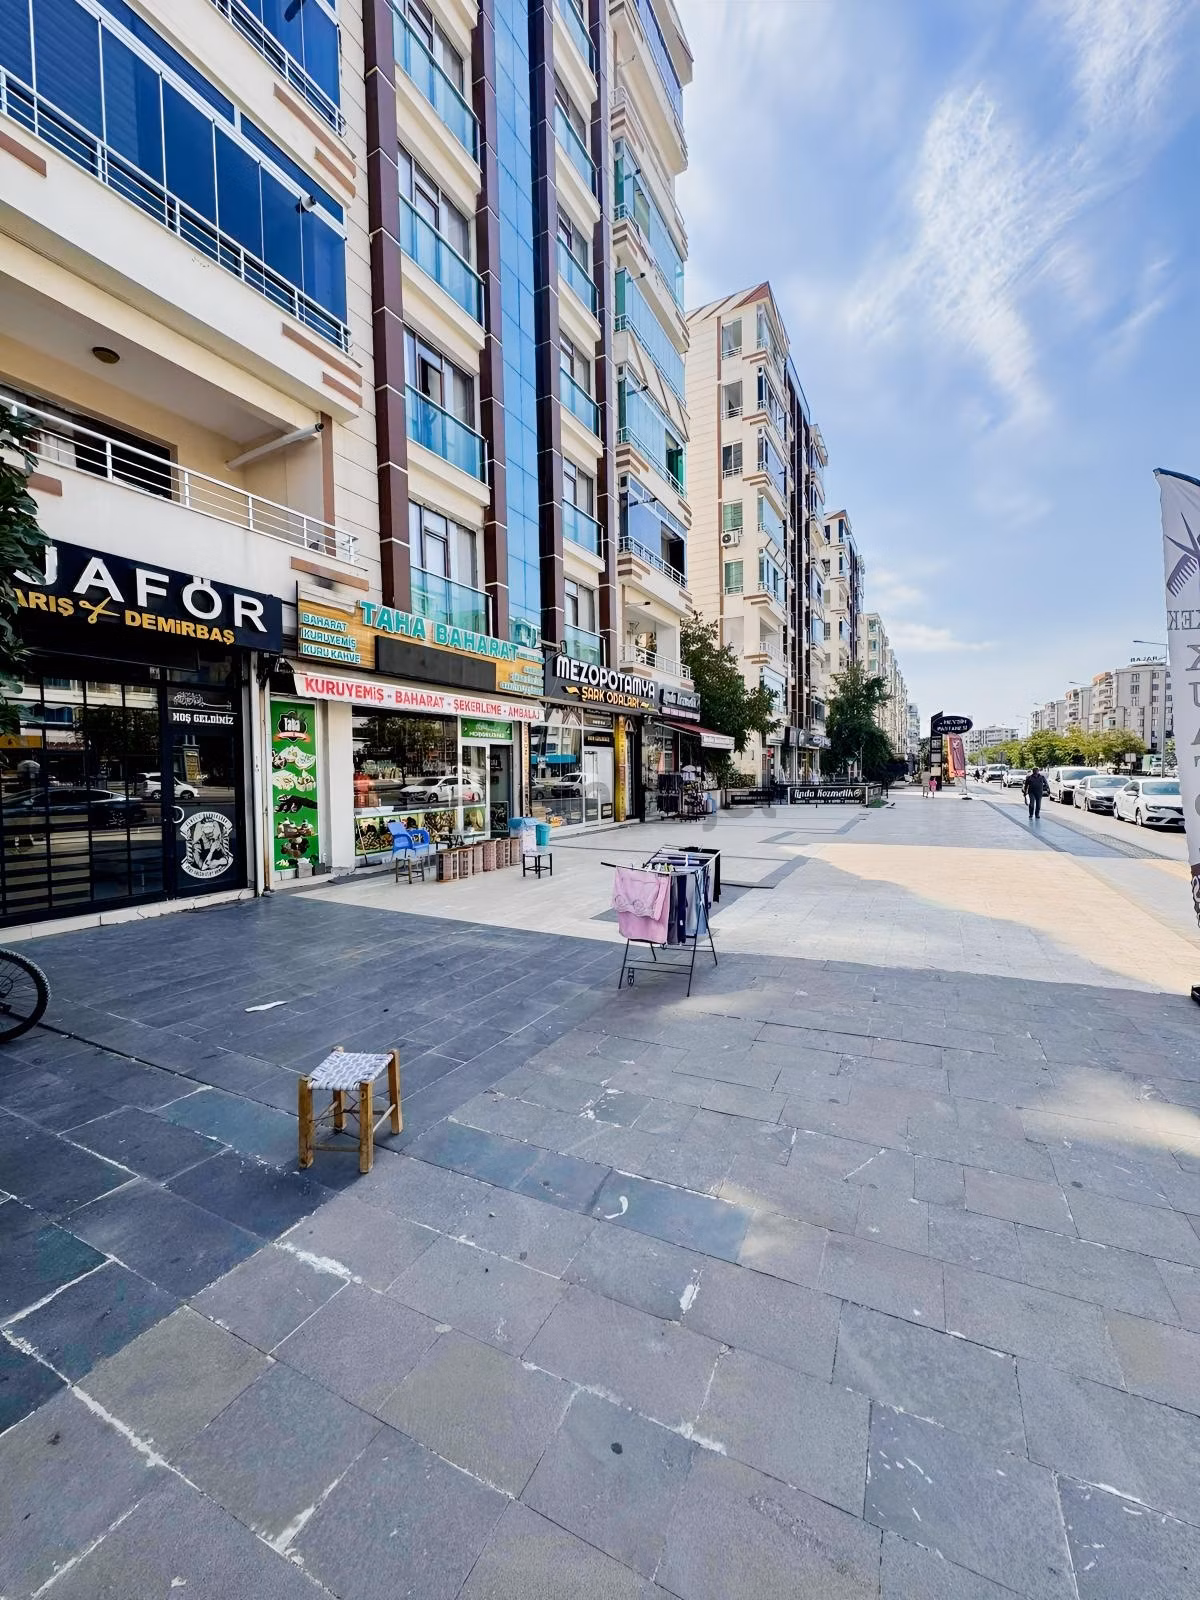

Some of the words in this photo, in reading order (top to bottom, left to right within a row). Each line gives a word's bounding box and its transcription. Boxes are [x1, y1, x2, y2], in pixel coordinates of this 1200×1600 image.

[14, 588, 75, 617] ARIŞ
[125, 610, 235, 645] DEMİRBAŞ
[302, 612, 348, 632] BAHARAT
[358, 600, 427, 641] TAHA
[433, 623, 519, 662] BAHARAT
[302, 643, 329, 657] KURU
[331, 649, 361, 664] KAHVE
[556, 655, 655, 700] MEZOPOTAMYA
[304, 676, 384, 704] KURUYEMİŞ
[395, 691, 444, 709] BAHARAT
[453, 699, 502, 716] ŞEKERLEME
[508, 708, 541, 721] AMBALAJ
[582, 686, 605, 703] ŞARK
[172, 712, 191, 724] HOŞ
